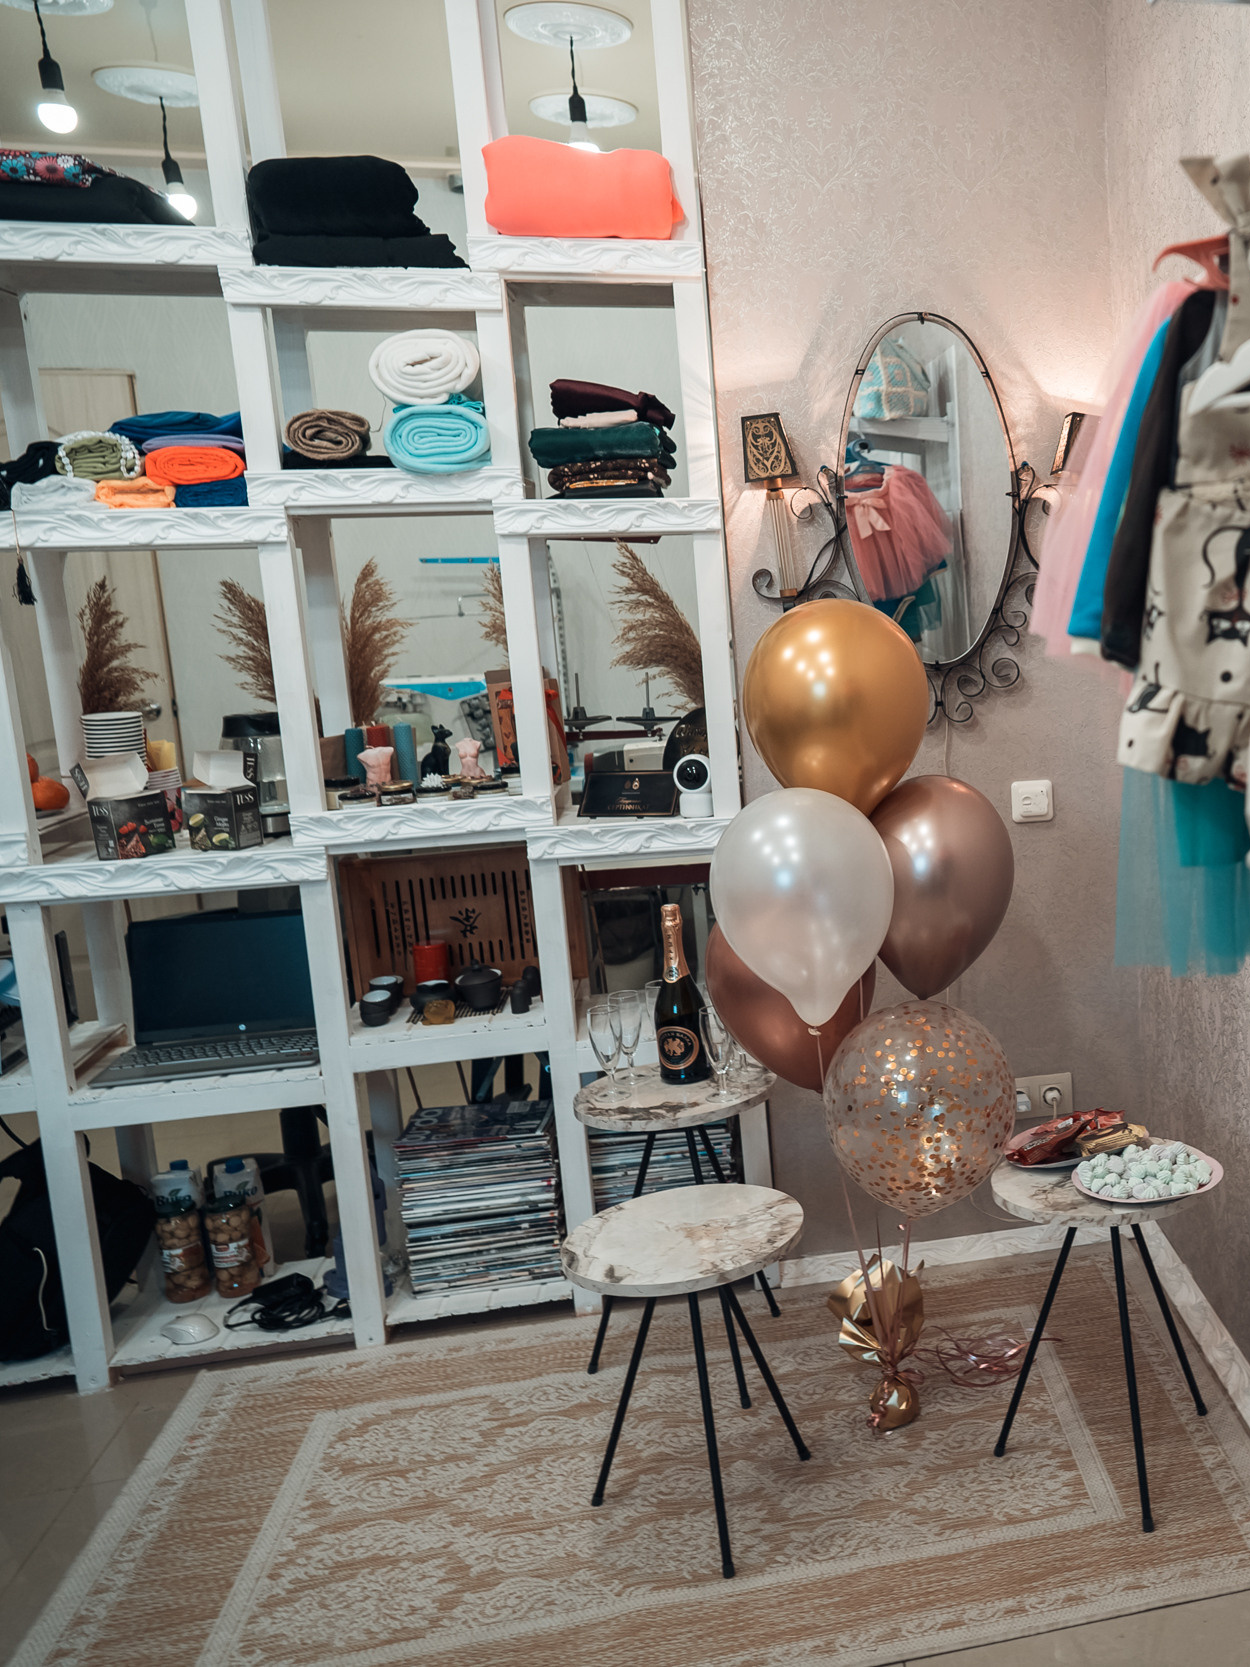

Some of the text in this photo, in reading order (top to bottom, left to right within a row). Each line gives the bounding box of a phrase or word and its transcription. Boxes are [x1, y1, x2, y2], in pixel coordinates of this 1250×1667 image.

[246, 757, 256, 780] TESS
[235, 793, 255, 806] TESS
[91, 805, 109, 817] TESS
